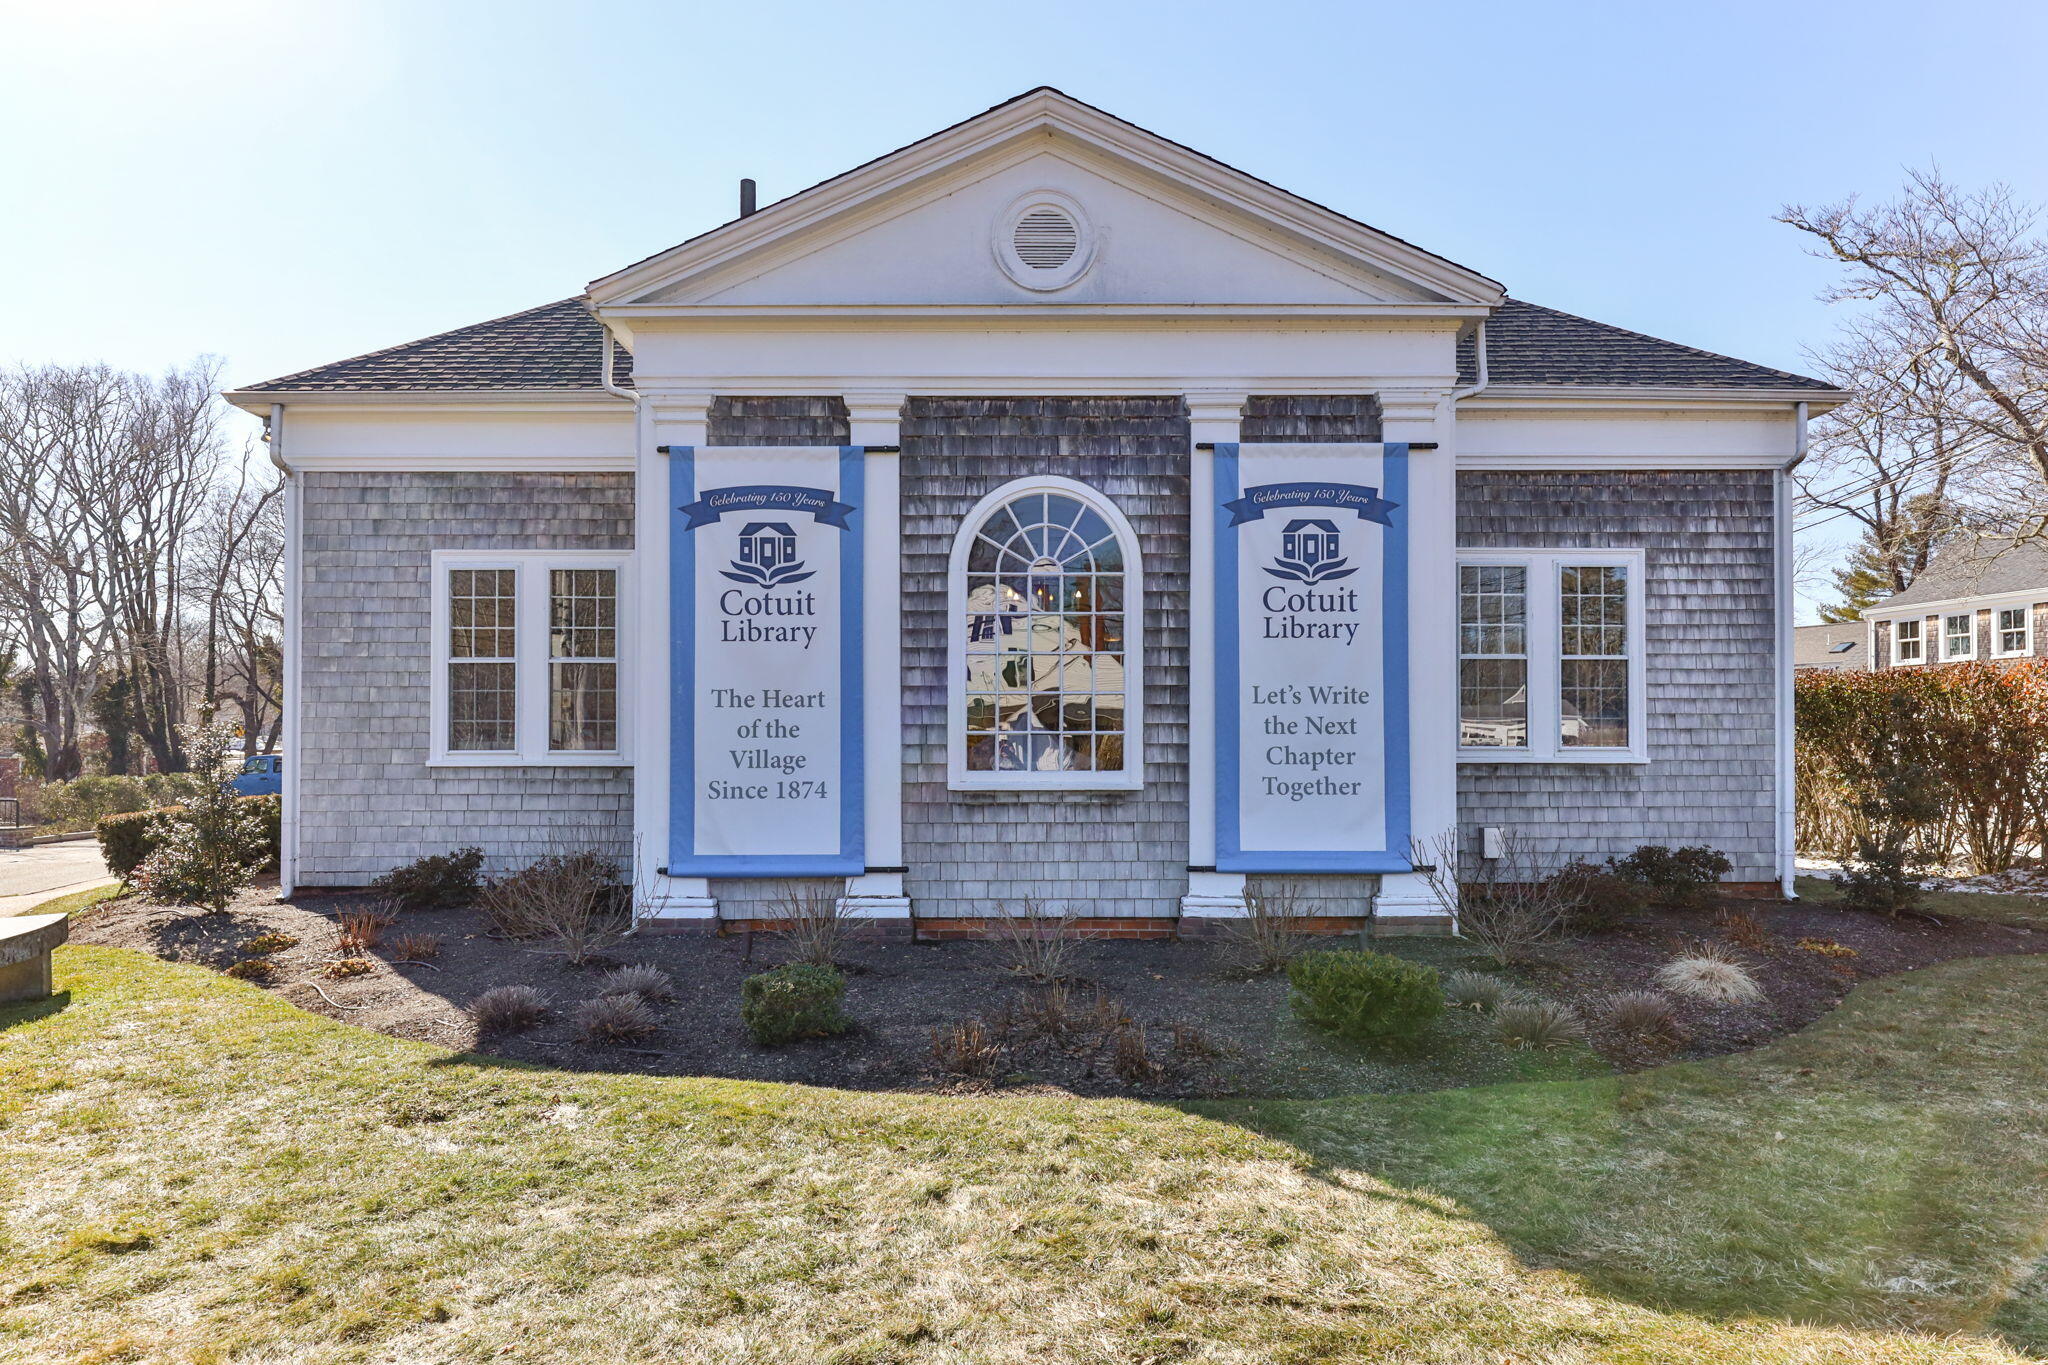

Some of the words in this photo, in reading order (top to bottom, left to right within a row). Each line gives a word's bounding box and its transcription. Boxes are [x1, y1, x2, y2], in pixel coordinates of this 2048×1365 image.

[709, 492, 768, 507] Celebrating
[770, 492, 791, 503] 150
[791, 492, 825, 507] Years
[1253, 489, 1311, 504] Celebrating
[1313, 488, 1335, 499] 150
[1335, 489, 1369, 504] Years
[719, 589, 816, 616] Cotuit
[1262, 585, 1359, 613] Cotuit
[720, 617, 818, 650] Library
[1262, 614, 1360, 647] Library
[710, 688, 756, 709] The
[761, 689, 826, 709] Heart
[1251, 684, 1302, 705] Let's
[1307, 685, 1370, 705] Write
[736, 718, 762, 739] of
[765, 718, 800, 739] the
[1263, 714, 1298, 735] the
[1304, 716, 1358, 735] Next
[728, 748, 807, 776] Village
[1265, 745, 1357, 772] Chapter
[707, 780, 768, 800] Since
[776, 780, 828, 800] 1874
[1261, 775, 1362, 802] Together
